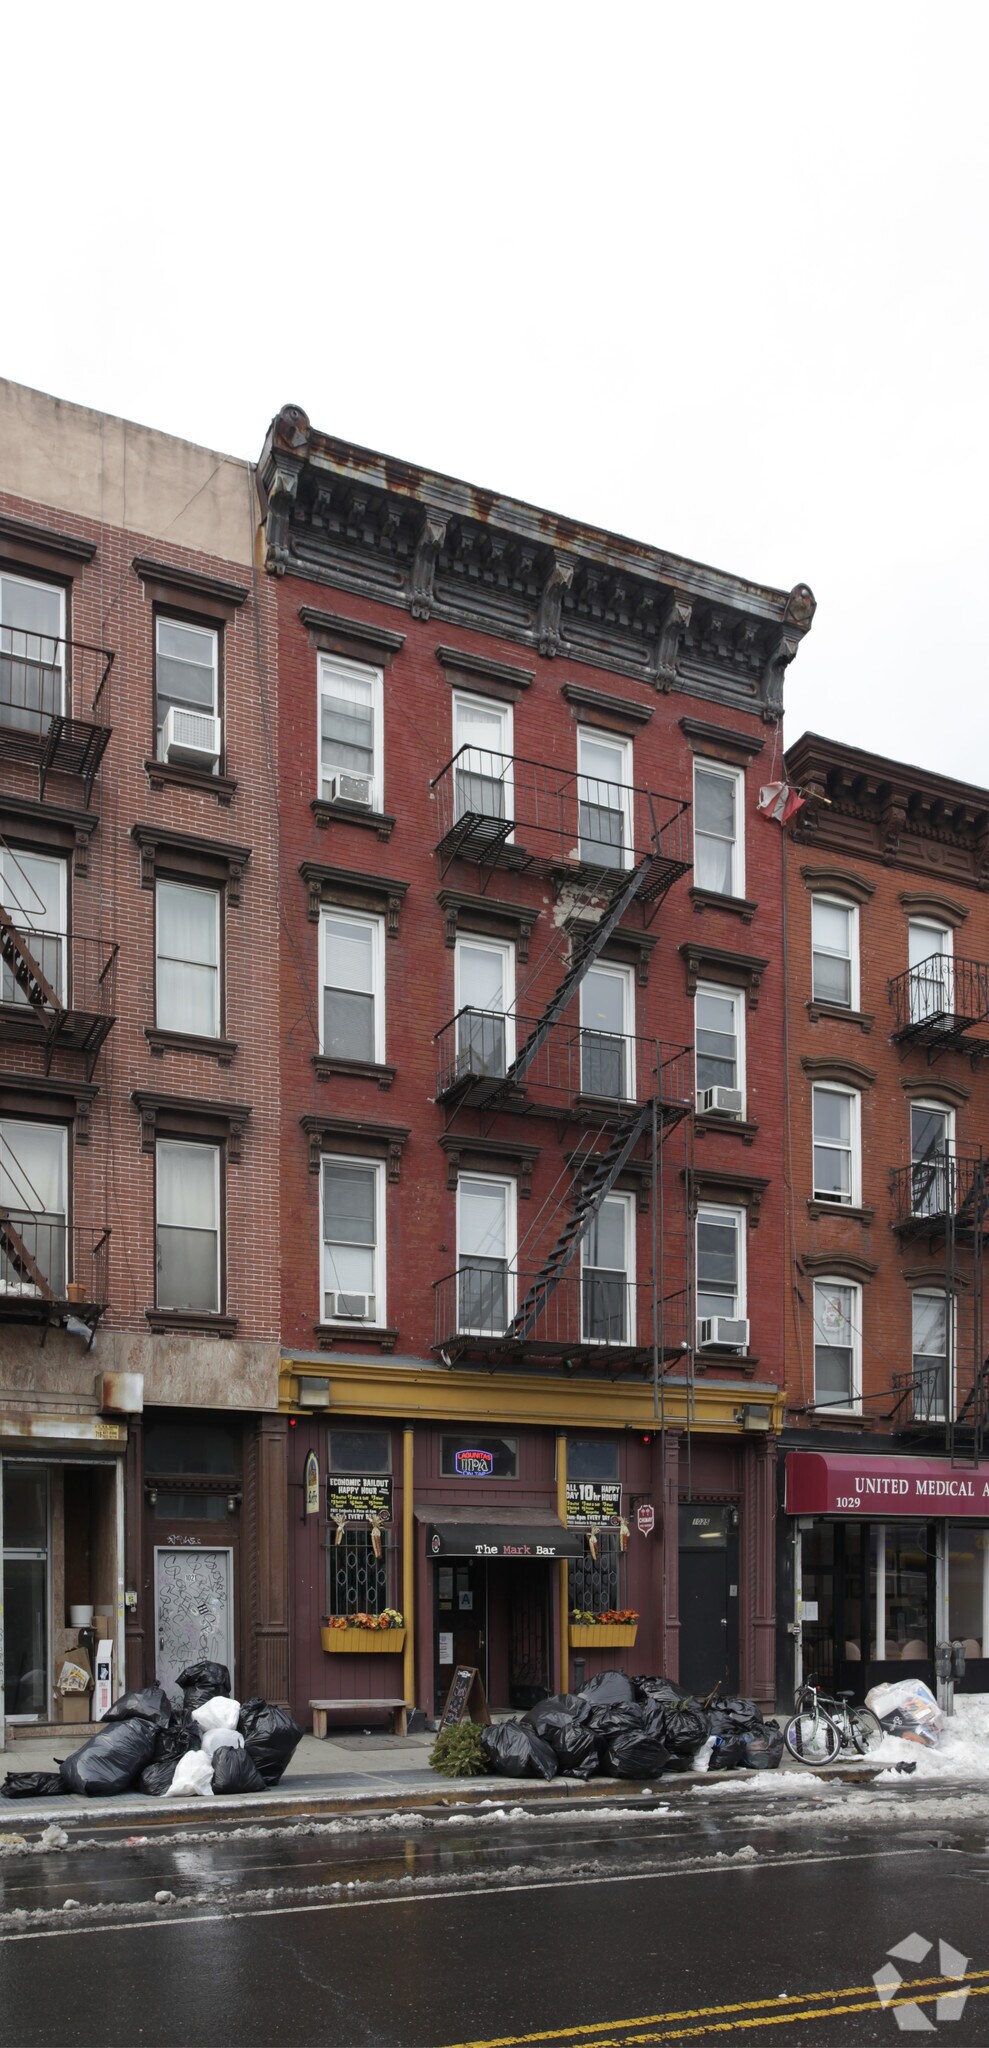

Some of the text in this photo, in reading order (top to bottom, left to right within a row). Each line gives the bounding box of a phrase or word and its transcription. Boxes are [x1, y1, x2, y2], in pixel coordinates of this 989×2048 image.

[458, 1452, 491, 1461] LAGUNITAS
[330, 1478, 389, 1487] ECONOMIC BAILOUT
[855, 1477, 909, 1494] UNITED
[915, 1480, 975, 1496] MEDICAL
[338, 1486, 359, 1494] HAPPY
[361, 1487, 378, 1495] HOUR
[601, 1485, 620, 1493] HAPPY
[566, 1491, 619, 1501] DAY HOUR!
[836, 1497, 861, 1508] 1029
[475, 1544, 556, 1555] The Mark Bar
[461, 1593, 470, 1605] A
